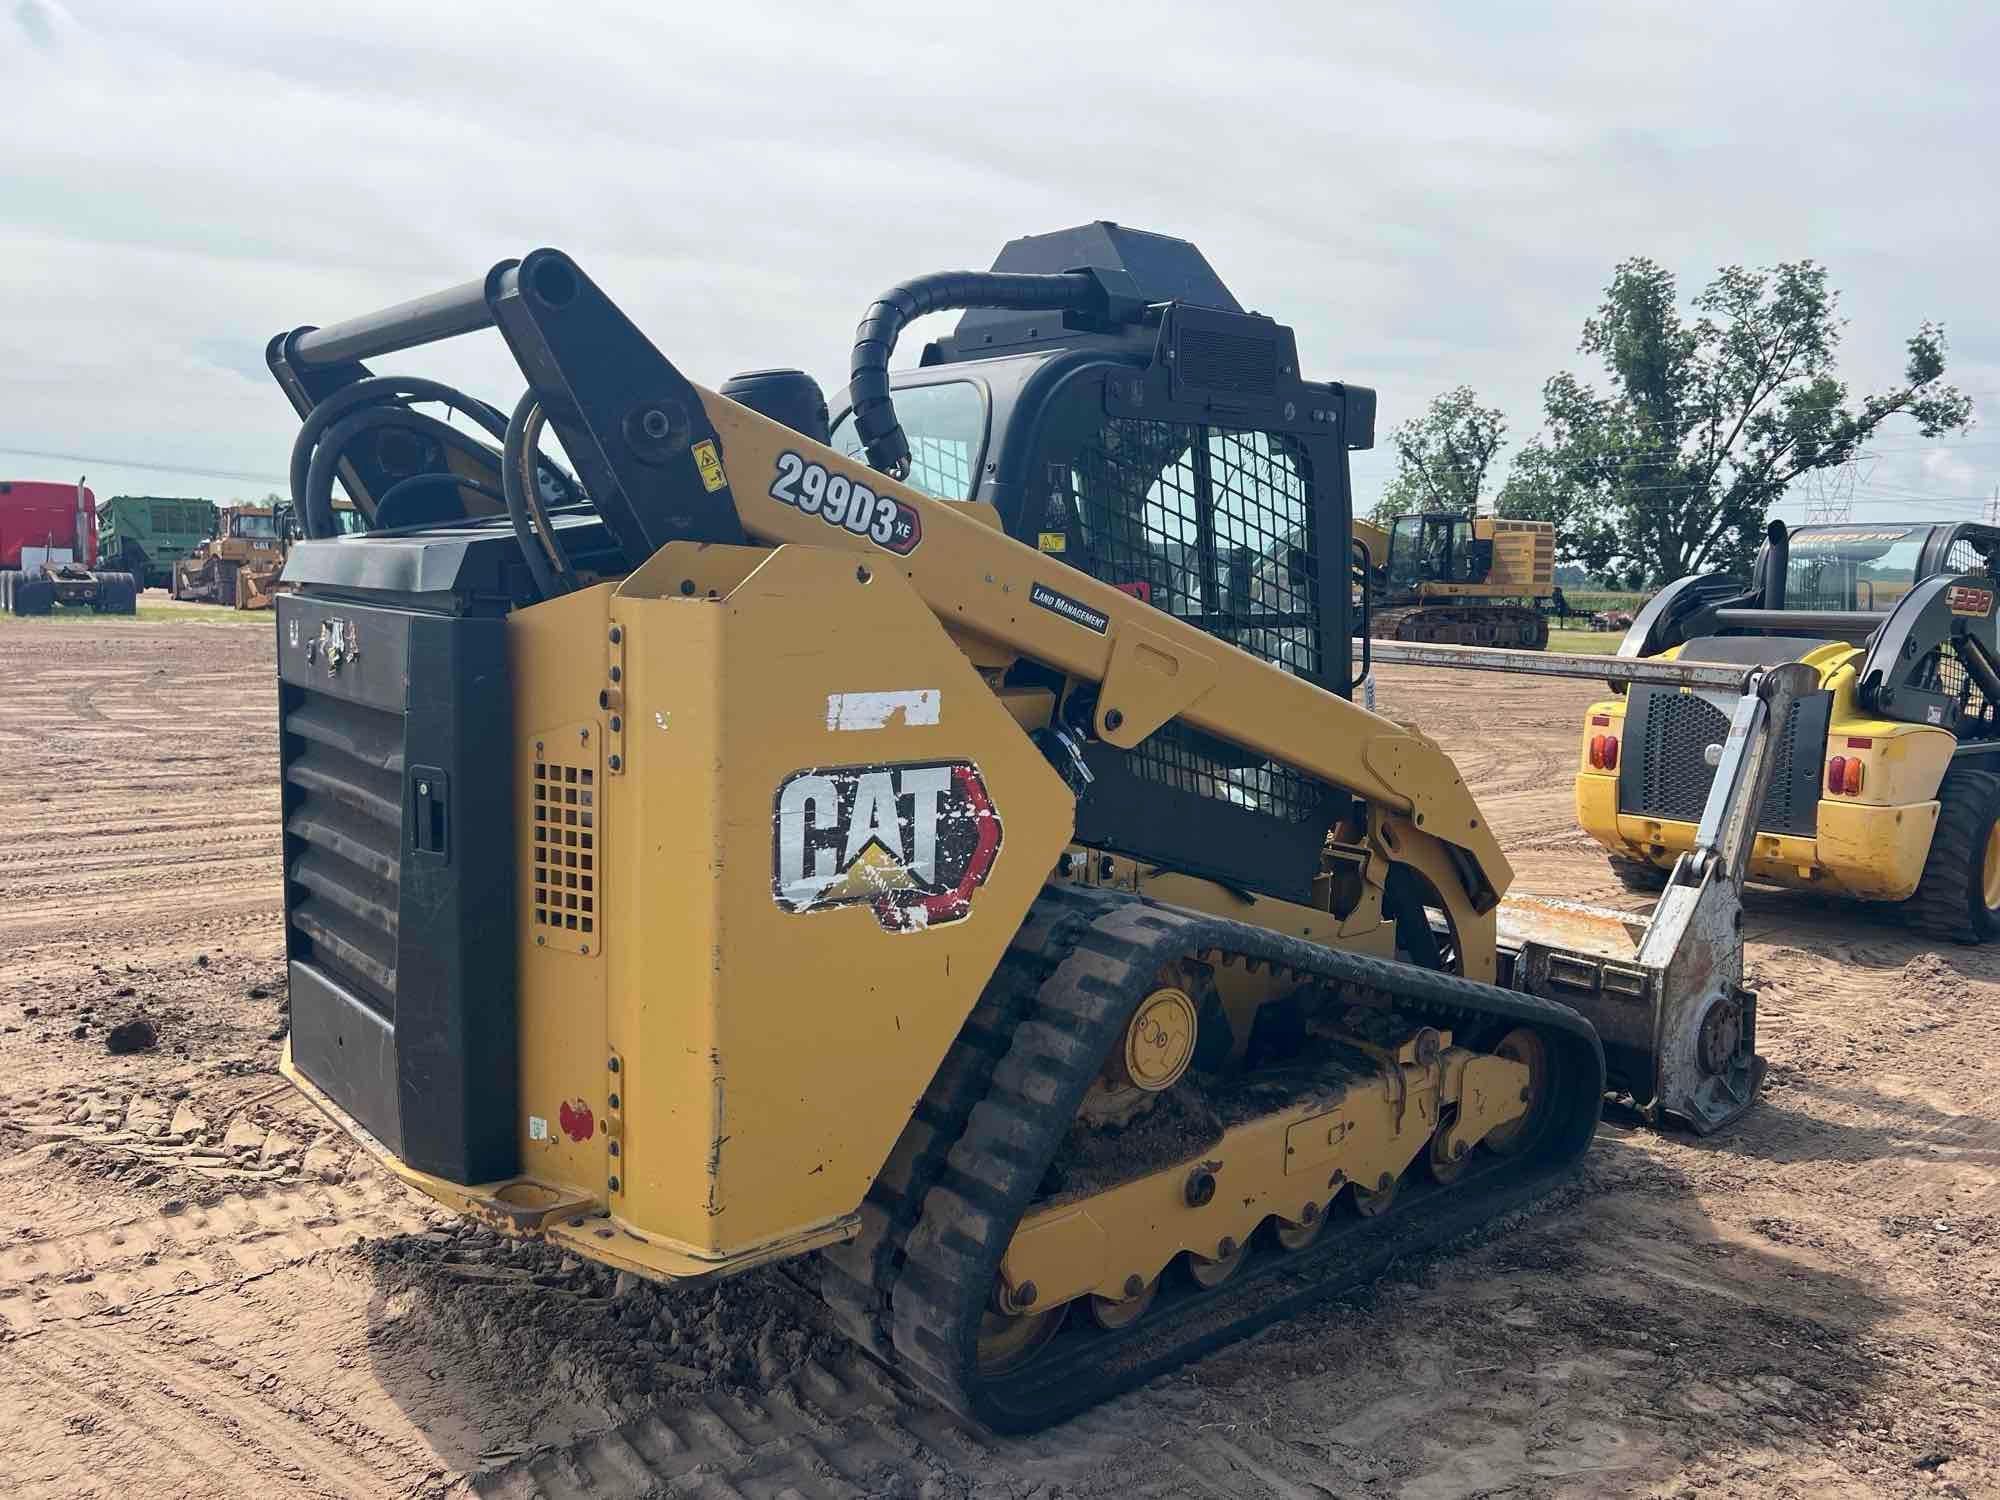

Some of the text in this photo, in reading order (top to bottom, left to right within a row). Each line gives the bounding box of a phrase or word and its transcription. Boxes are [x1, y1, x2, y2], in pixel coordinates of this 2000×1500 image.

[770, 451, 912, 544] 299D3 XE
[779, 766, 951, 905] CAT
